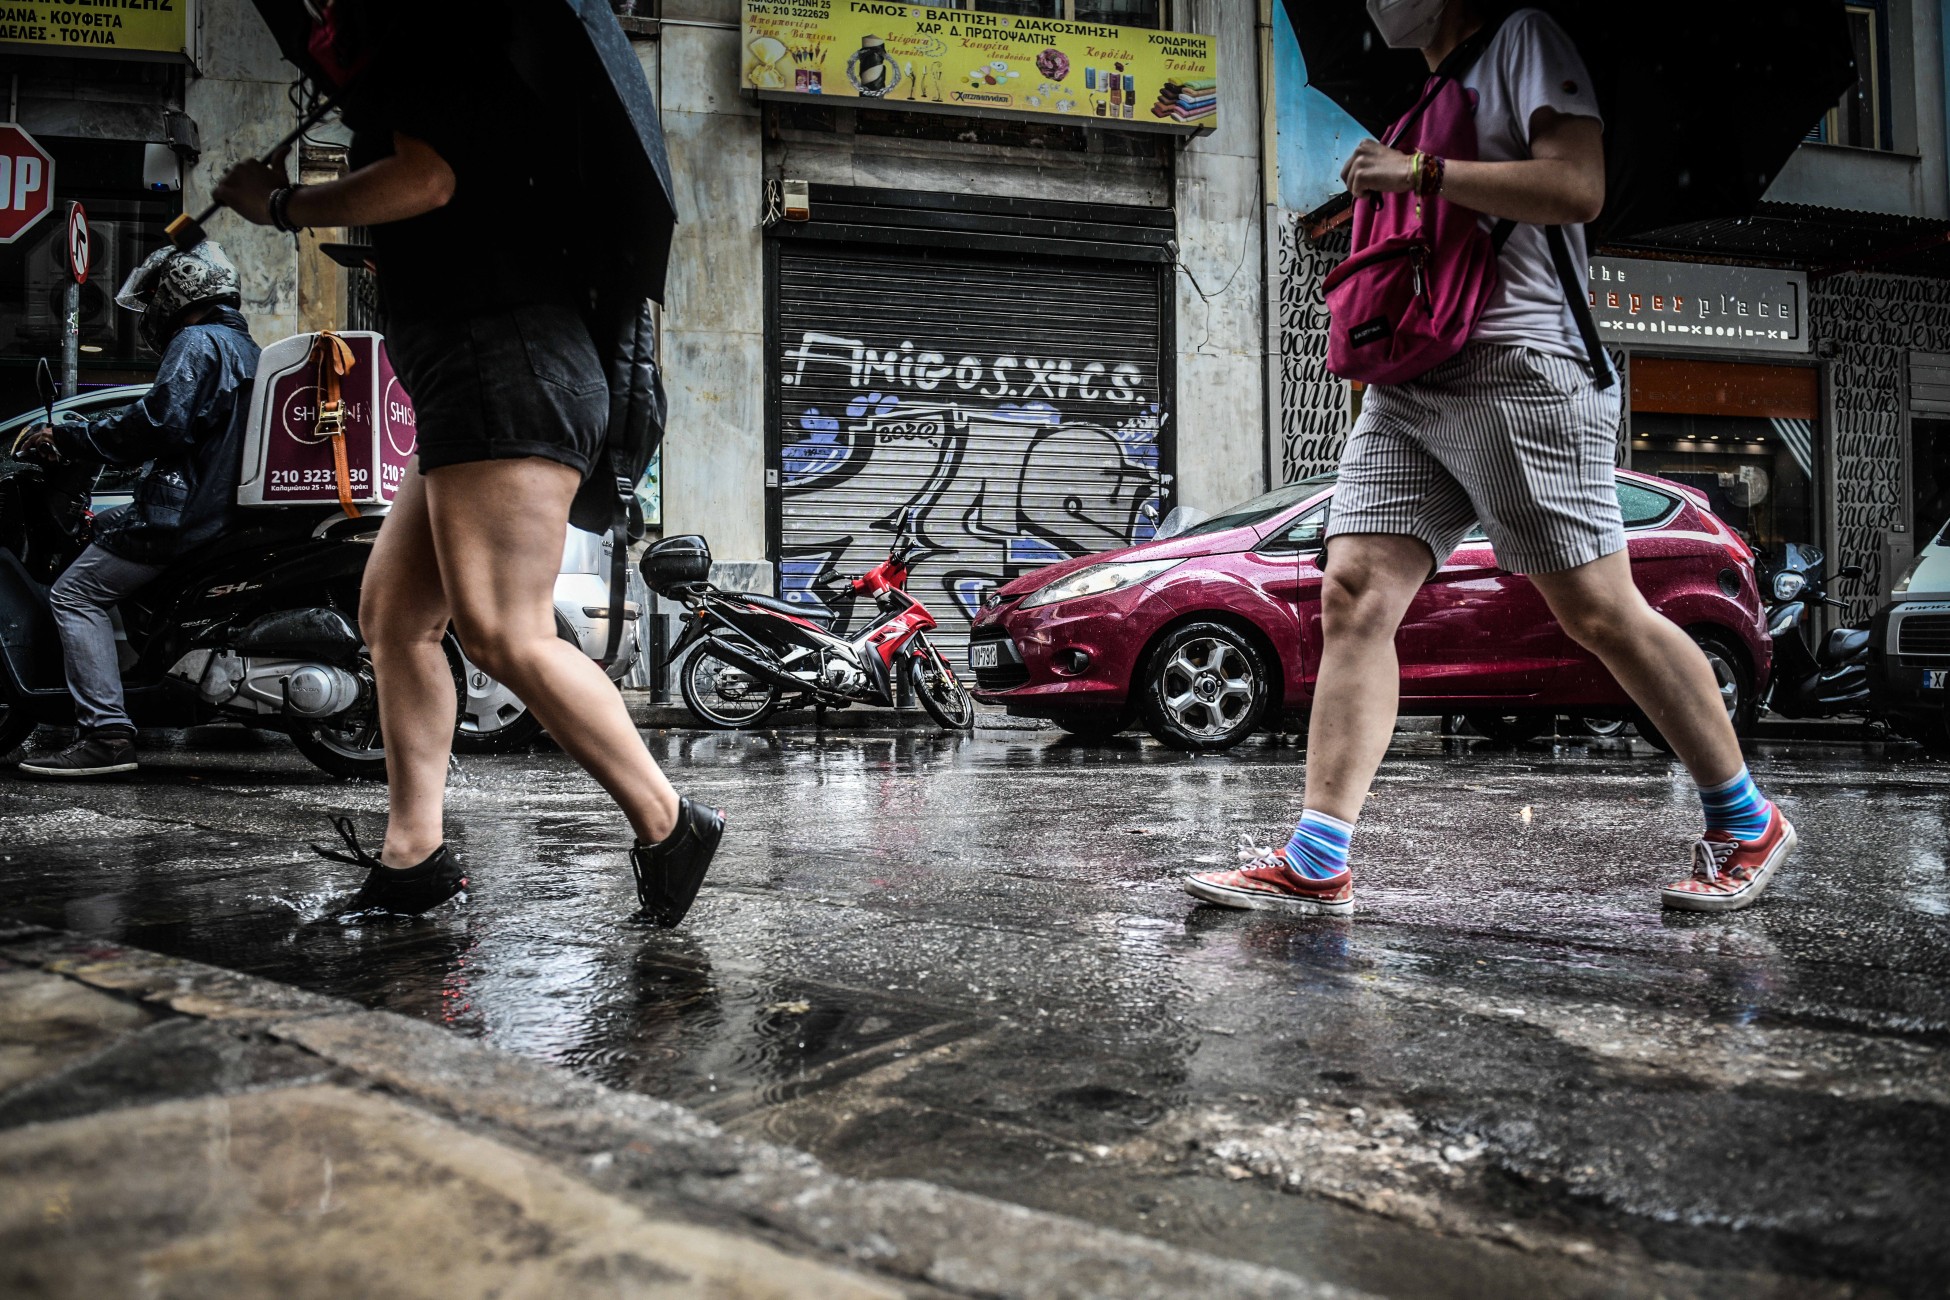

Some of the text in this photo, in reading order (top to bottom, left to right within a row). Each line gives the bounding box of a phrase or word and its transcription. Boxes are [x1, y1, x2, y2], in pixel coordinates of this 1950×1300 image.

[748, 4, 829, 20] ΤΗΛ: 210 3222629
[821, 1, 831, 9] 25
[50, 10, 122, 29] ΚΟΥΦΕΤΑ
[850, 2, 1119, 39] ΓΑΜΟΣ ΒΑΠΤΙΣΗ ΔΙΑΚΟΣΜΗΣΗ
[60, 27, 115, 45] ΤΟΥΛΙΑ
[916, 22, 1057, 46] ΧΑΡ. Δ. ΠΡΩΤΟΨΑΛΤΗΣ
[1148, 34, 1207, 48] ΧΟΝΔΡΙΚΗ
[1161, 46, 1207, 59] ΛΙΑΝΙΚΗ
[1589, 265, 1626, 282] the
[1698, 294, 1789, 318] place
[271, 469, 369, 484] 210 323130
[382, 462, 399, 482] 210
